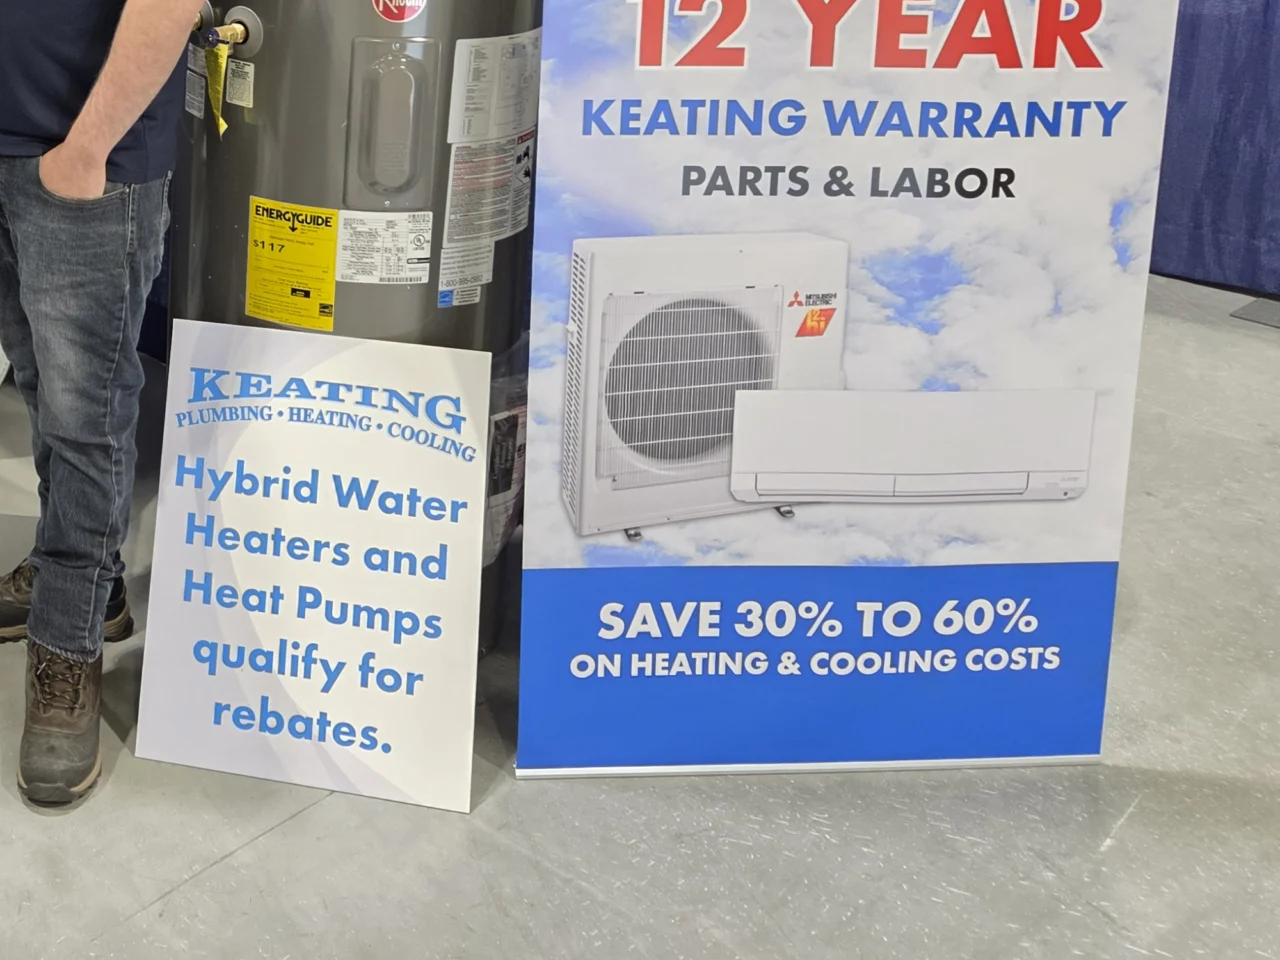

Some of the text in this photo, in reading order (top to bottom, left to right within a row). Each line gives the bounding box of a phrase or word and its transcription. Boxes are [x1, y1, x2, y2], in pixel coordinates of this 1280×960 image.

[581, 98, 1128, 139] KEATING WARRANTY
[681, 165, 1017, 199] PARTS & LABOR
[255, 205, 332, 229] ENERGYGUIDE
[187, 367, 467, 434] KEATING
[176, 405, 477, 463] PLUMBING HEATING COOLING
[175, 454, 468, 523] Hybrid Water
[185, 512, 448, 581] Heaters and
[183, 569, 443, 644] Heat Pumps
[598, 598, 1039, 639] SAVE 30% TO 60%
[193, 638, 424, 696] qualify for
[570, 646, 1061, 678] ON HEATING & COOLING COSTS
[213, 695, 392, 753] rebates.
